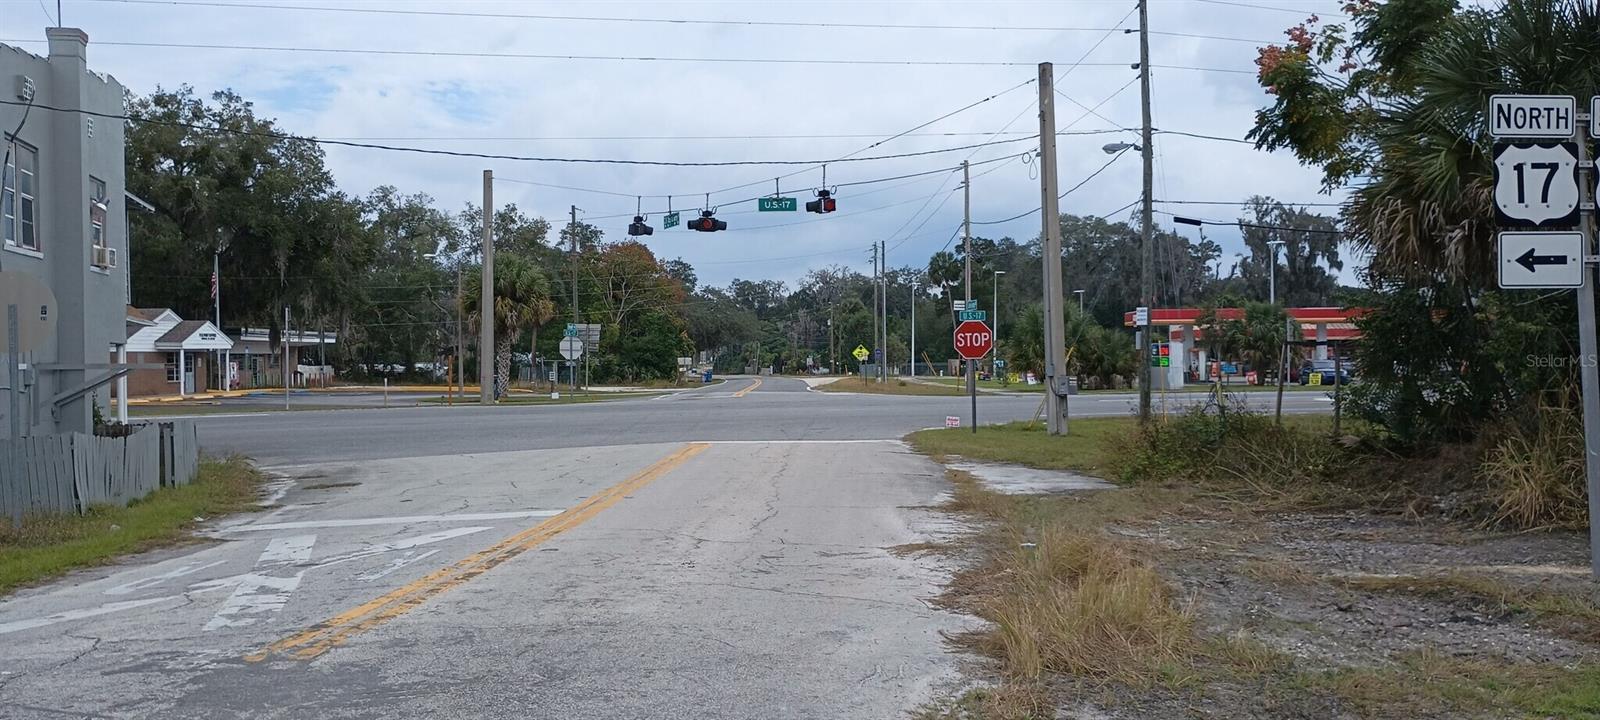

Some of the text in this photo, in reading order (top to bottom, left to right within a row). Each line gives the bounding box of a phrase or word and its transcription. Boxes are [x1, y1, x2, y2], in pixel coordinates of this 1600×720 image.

[1496, 103, 1569, 129] NORTH
[1513, 162, 1559, 204] 17
[957, 332, 990, 347] STOP
